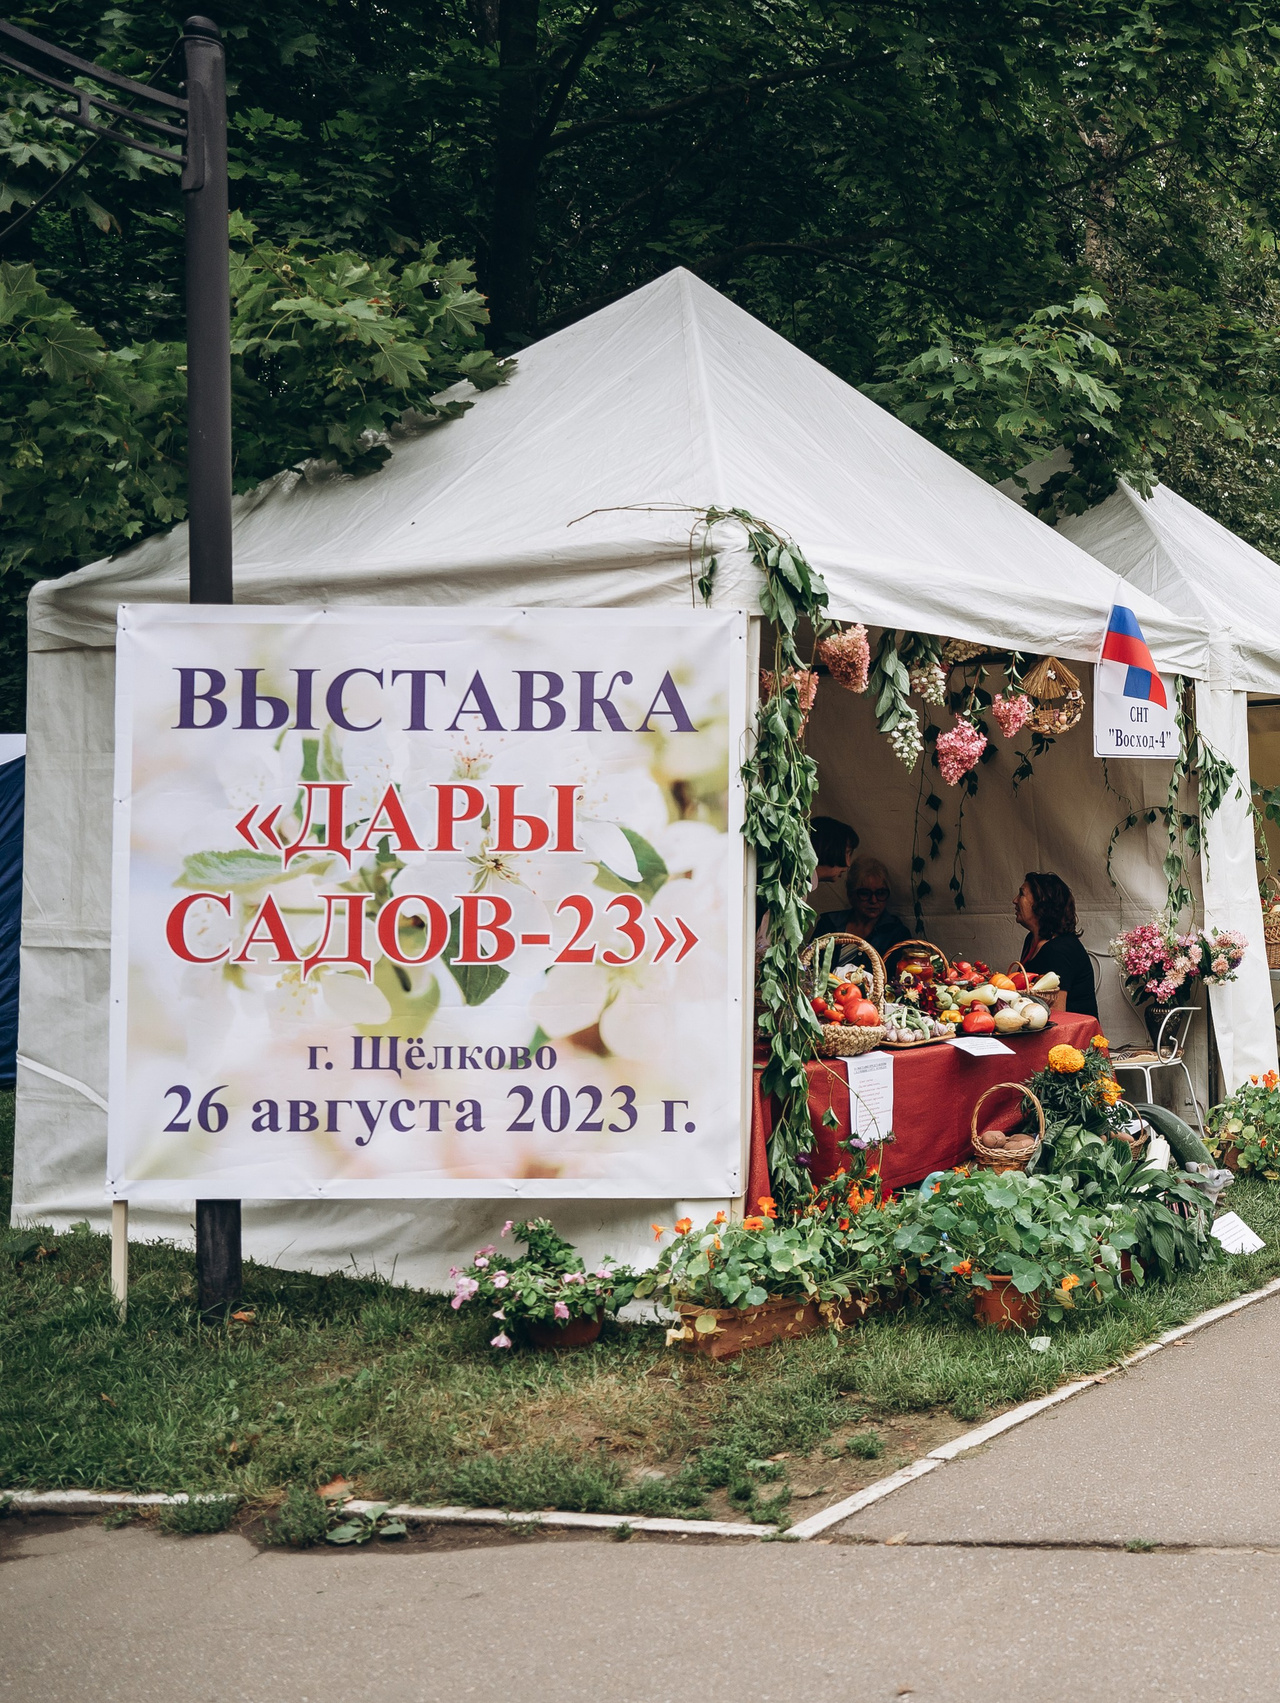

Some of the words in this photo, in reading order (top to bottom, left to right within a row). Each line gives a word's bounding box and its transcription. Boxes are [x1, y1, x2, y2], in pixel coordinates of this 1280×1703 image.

[171, 667, 699, 733] ВЫСТАВКА
[1130, 706, 1149, 723] СНТ
[1108, 728, 1171, 749] "Восход-4"
[235, 782, 583, 870] «ДАРЫ
[166, 893, 699, 981] САДОВ-23»
[307, 1045, 334, 1071] г.
[352, 1035, 558, 1077] Щёлково
[163, 1085, 229, 1133] 26
[251, 1098, 486, 1146] августа
[506, 1086, 638, 1133] 2023
[661, 1100, 696, 1134] г.
